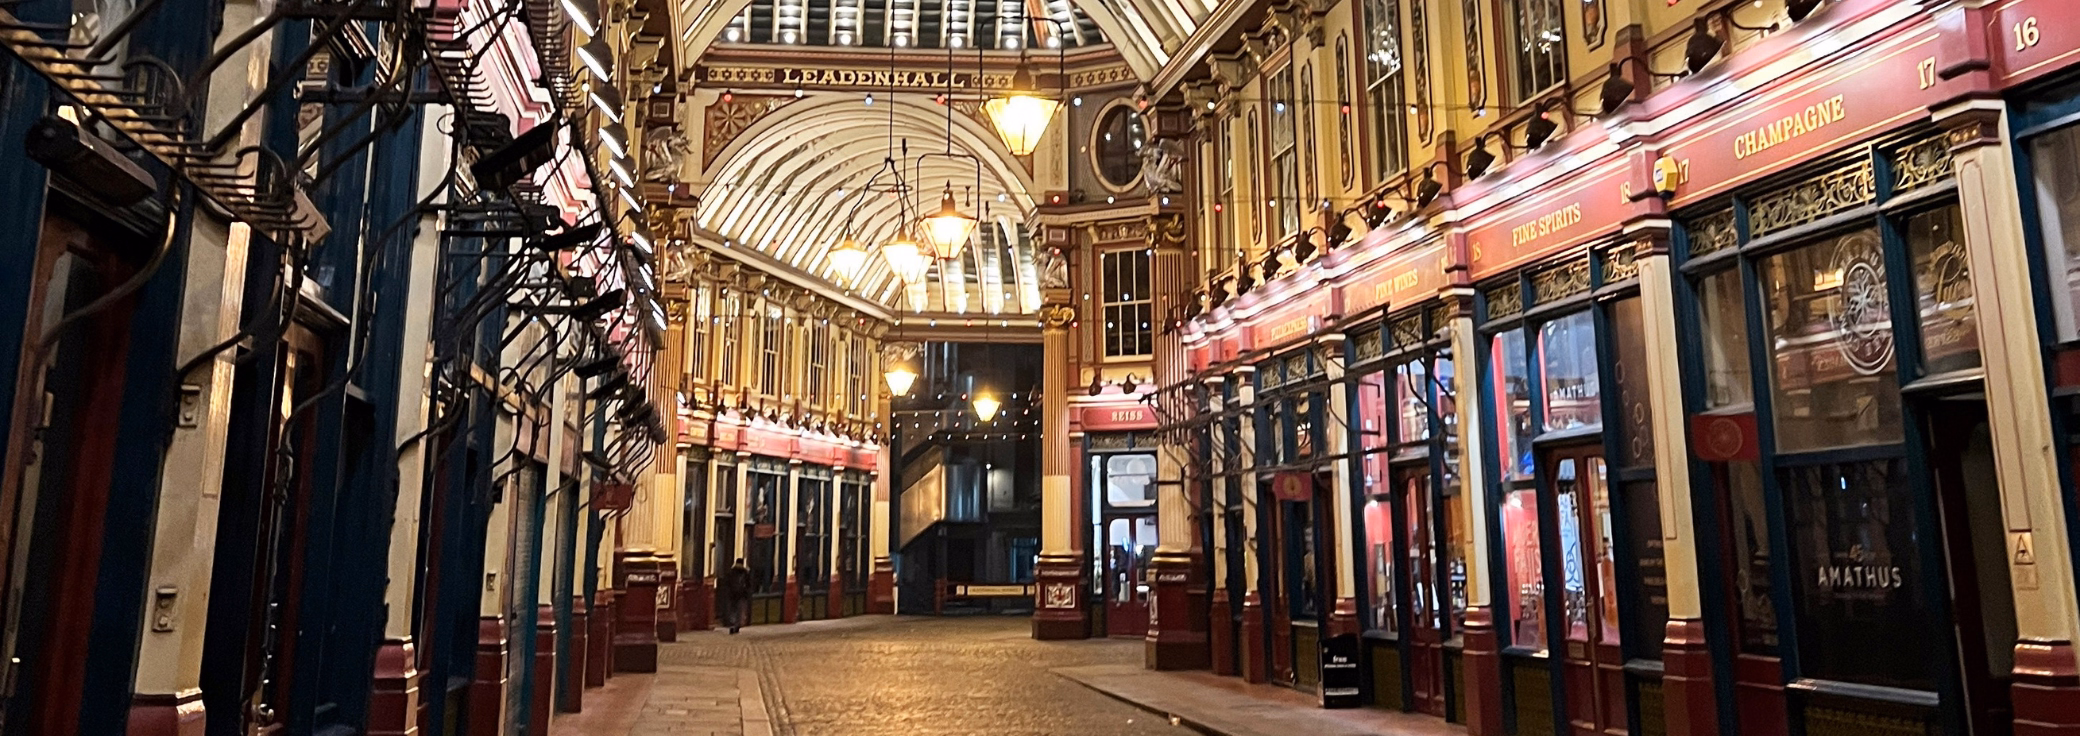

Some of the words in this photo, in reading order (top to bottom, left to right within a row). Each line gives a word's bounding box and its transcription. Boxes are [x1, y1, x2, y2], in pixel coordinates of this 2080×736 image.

[2013, 17, 2040, 53] 16
[783, 68, 965, 88] LEADENHALL
[1916, 56, 1937, 90] 17
[1733, 93, 1846, 160] CHAMPAGNE
[1677, 158, 1690, 185] 17
[1619, 181, 1632, 205] 18
[1512, 221, 1537, 247] FINE
[1538, 202, 1582, 238] SPIRITS
[1393, 267, 1419, 293] WINES
[1111, 410, 1143, 422] REISS
[1817, 565, 1902, 588] AMATHUS
